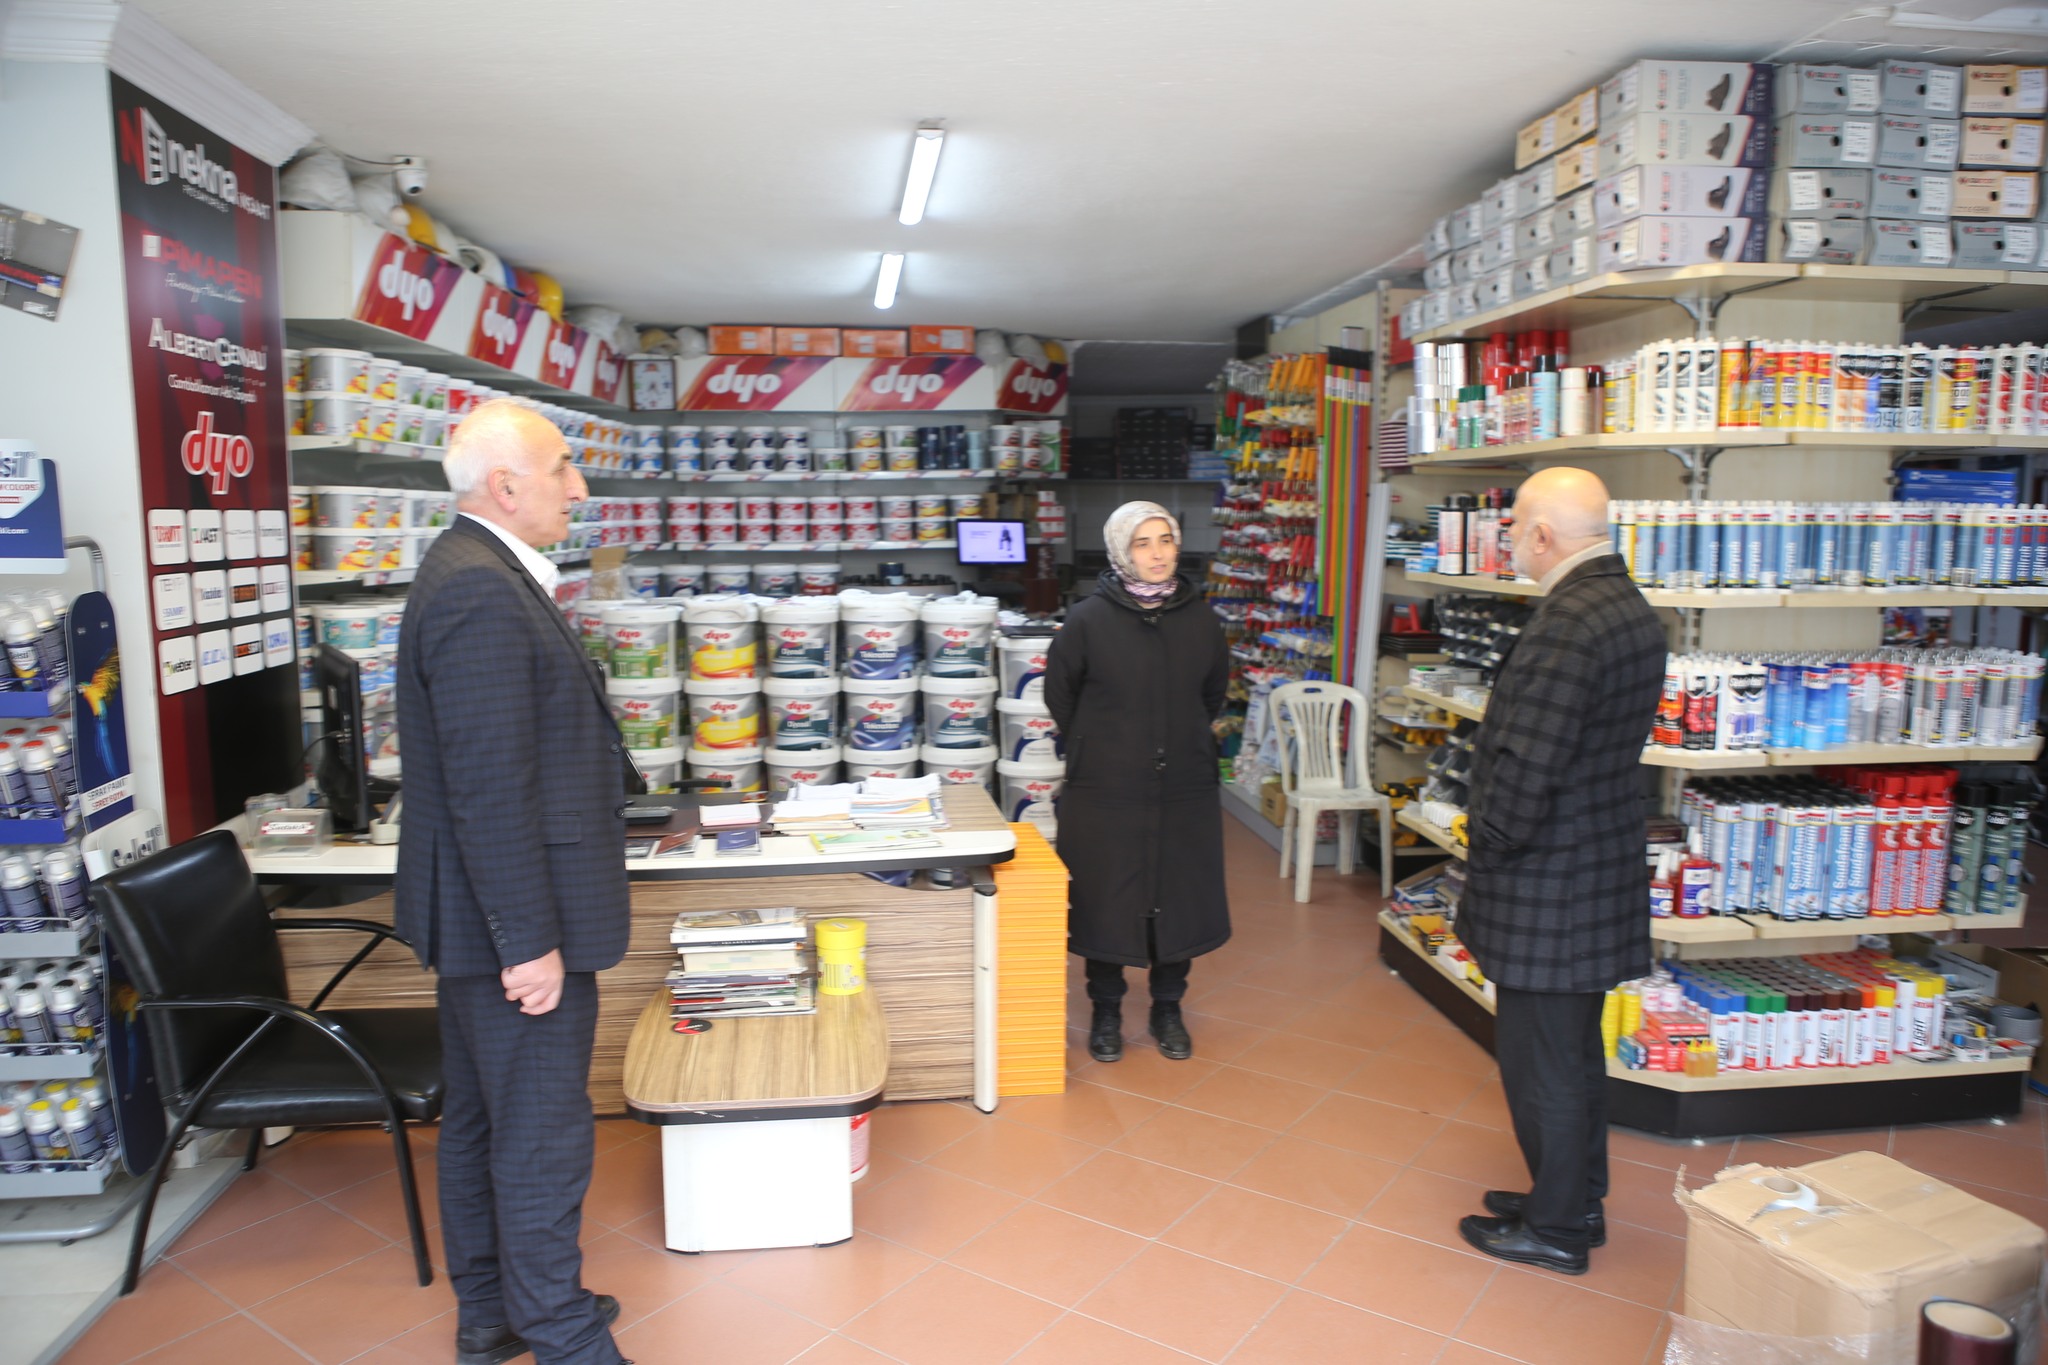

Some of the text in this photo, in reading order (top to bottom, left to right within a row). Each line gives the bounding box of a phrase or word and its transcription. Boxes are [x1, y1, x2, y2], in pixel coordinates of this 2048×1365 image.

[378, 250, 435, 321] dyo
[481, 296, 517, 355] dyo
[706, 364, 782, 403] dyo
[870, 363, 945, 403] dyo
[1011, 366, 1057, 404] dyo
[181, 411, 254, 495] dyo
[615, 629, 642, 641] dyo
[704, 630, 731, 642] dyo
[779, 628, 807, 641] dyo
[864, 628, 893, 641] dyo
[943, 627, 970, 640] dyo
[624, 700, 651, 711] dyo
[710, 702, 737, 713] dyo
[785, 700, 813, 713] dyo
[867, 700, 896, 712] dyo
[948, 699, 976, 712] dyo
[1026, 719, 1054, 730] dyo
[791, 770, 818, 782] dyo
[947, 769, 974, 781] dyo
[1026, 782, 1053, 794] dyo
[1788, 826, 1804, 890] Soudafoam
[1802, 824, 1818, 888] Soudafoam
[1833, 825, 1852, 889] Soudafoam
[1848, 824, 1869, 887] Soudafoam
[1913, 1018, 1926, 1047] LIGHT
